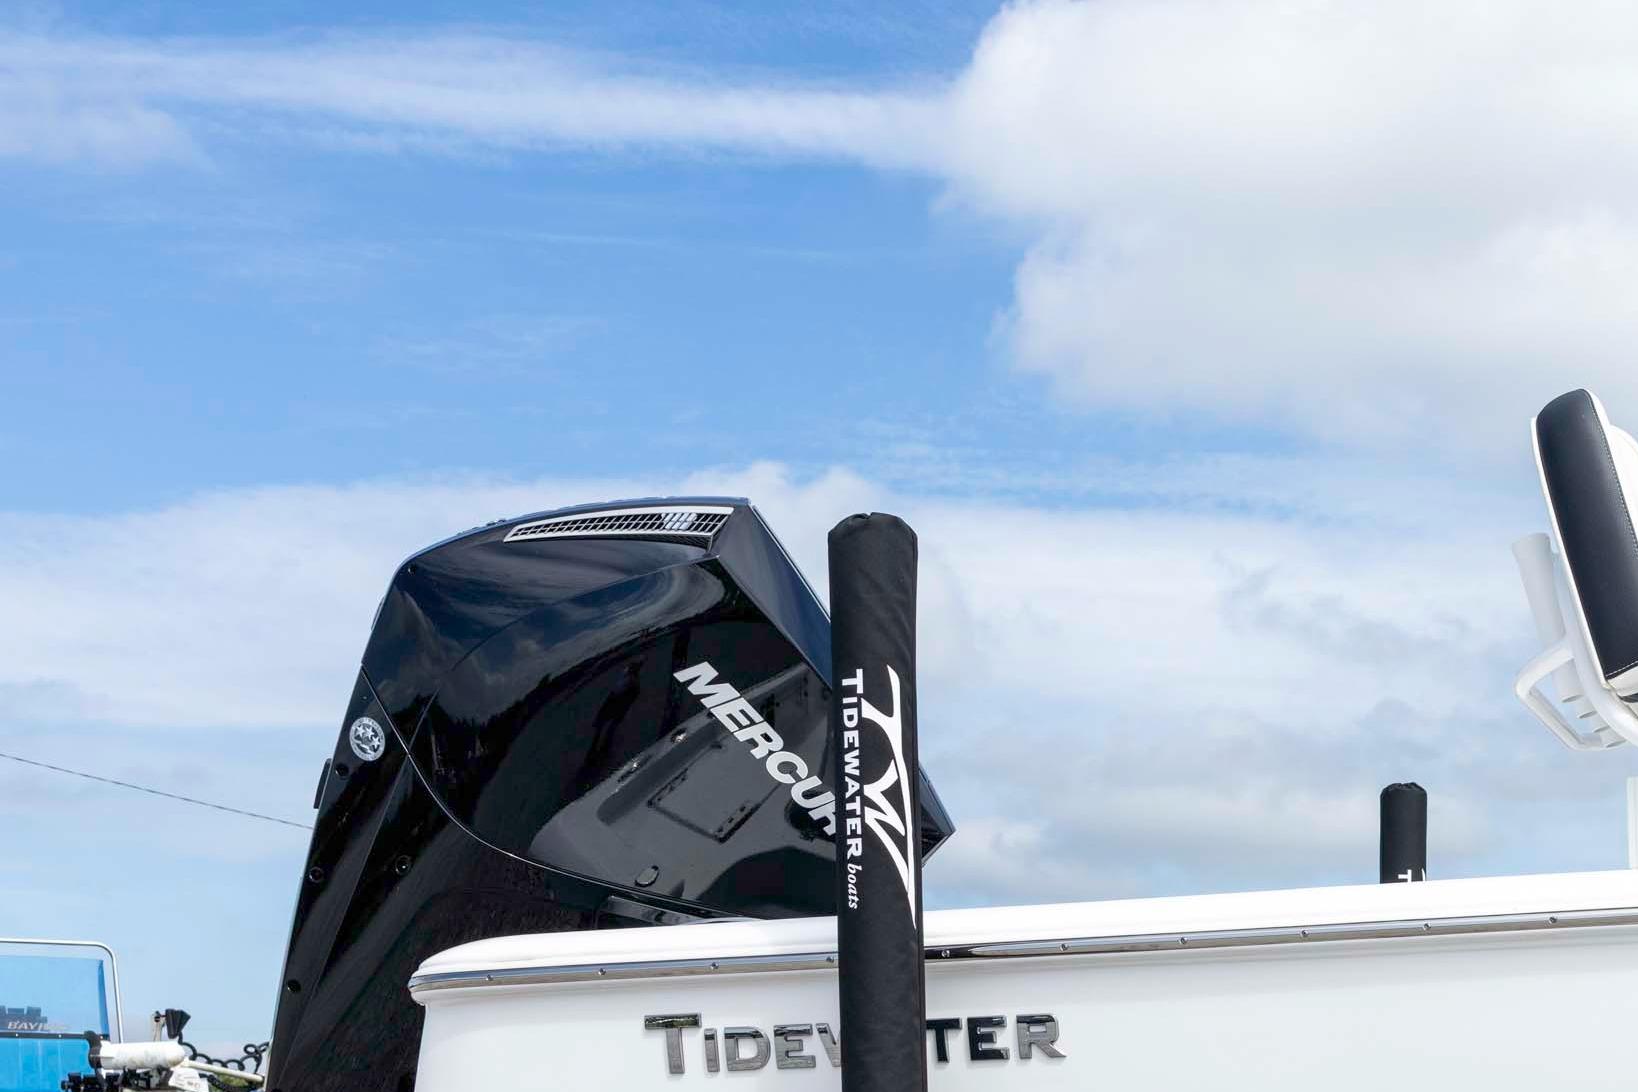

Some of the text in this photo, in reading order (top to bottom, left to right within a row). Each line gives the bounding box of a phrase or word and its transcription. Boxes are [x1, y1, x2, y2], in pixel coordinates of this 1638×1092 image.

[673, 660, 837, 837] MERCUR
[841, 668, 864, 911] TIDEWATER boats
[644, 1012, 1068, 1076] TIDETER
